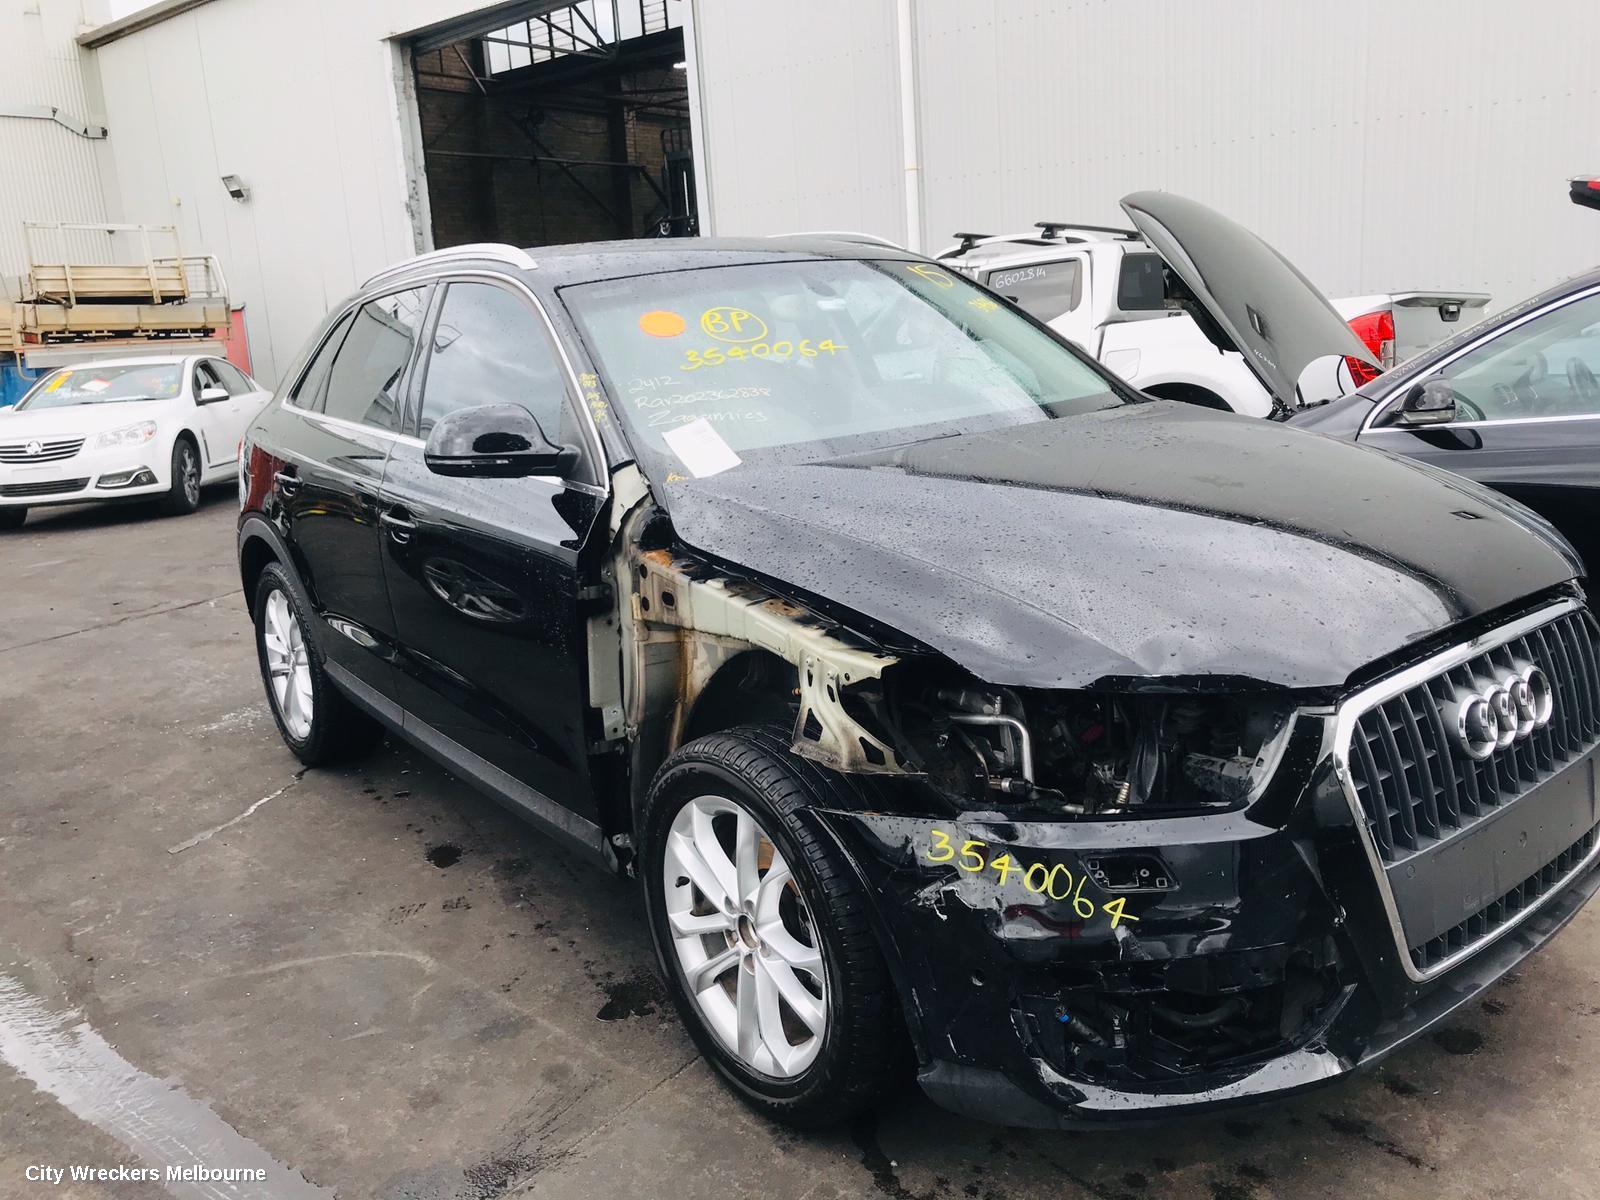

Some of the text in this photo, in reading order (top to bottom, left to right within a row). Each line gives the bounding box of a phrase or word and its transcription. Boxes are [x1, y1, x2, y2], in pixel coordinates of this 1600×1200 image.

[703, 311, 750, 334] BP
[679, 339, 849, 373] 3540064
[926, 829, 1140, 930] 3540064
